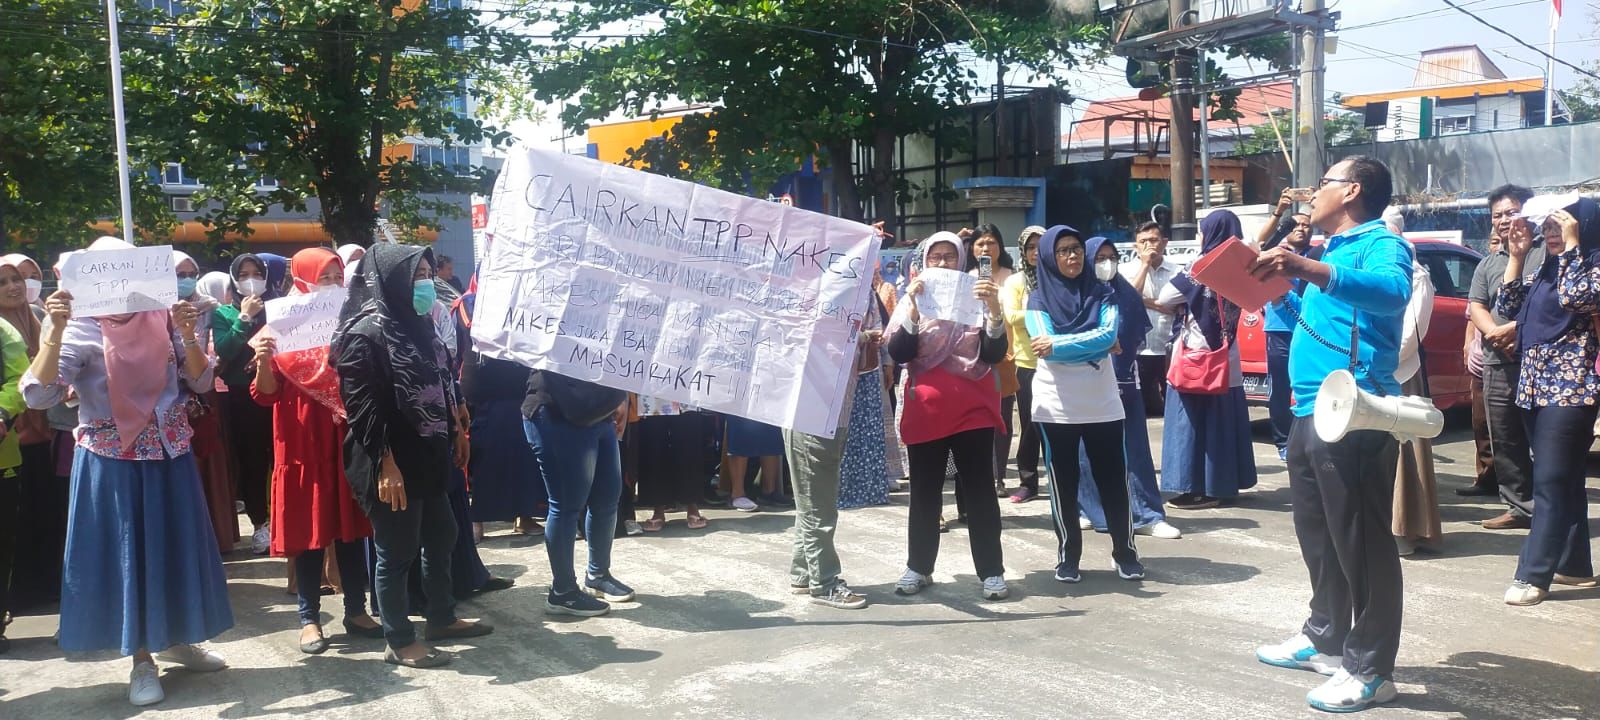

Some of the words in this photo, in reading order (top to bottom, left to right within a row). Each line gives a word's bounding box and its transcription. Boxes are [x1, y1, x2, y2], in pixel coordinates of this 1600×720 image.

[525, 174, 688, 237] CAIRKAN
[693, 217, 753, 253] TPP
[763, 231, 862, 279] NAKES
[81, 260, 134, 275] CAIRKAN
[593, 243, 680, 285] BULAN
[93, 278, 129, 295] TPP
[501, 306, 567, 336] NAKES
[574, 324, 610, 345] JUGA
[510, 273, 600, 308] NAKES
[671, 306, 774, 354] MANUSIA
[569, 343, 716, 396] MASYARAKAT
